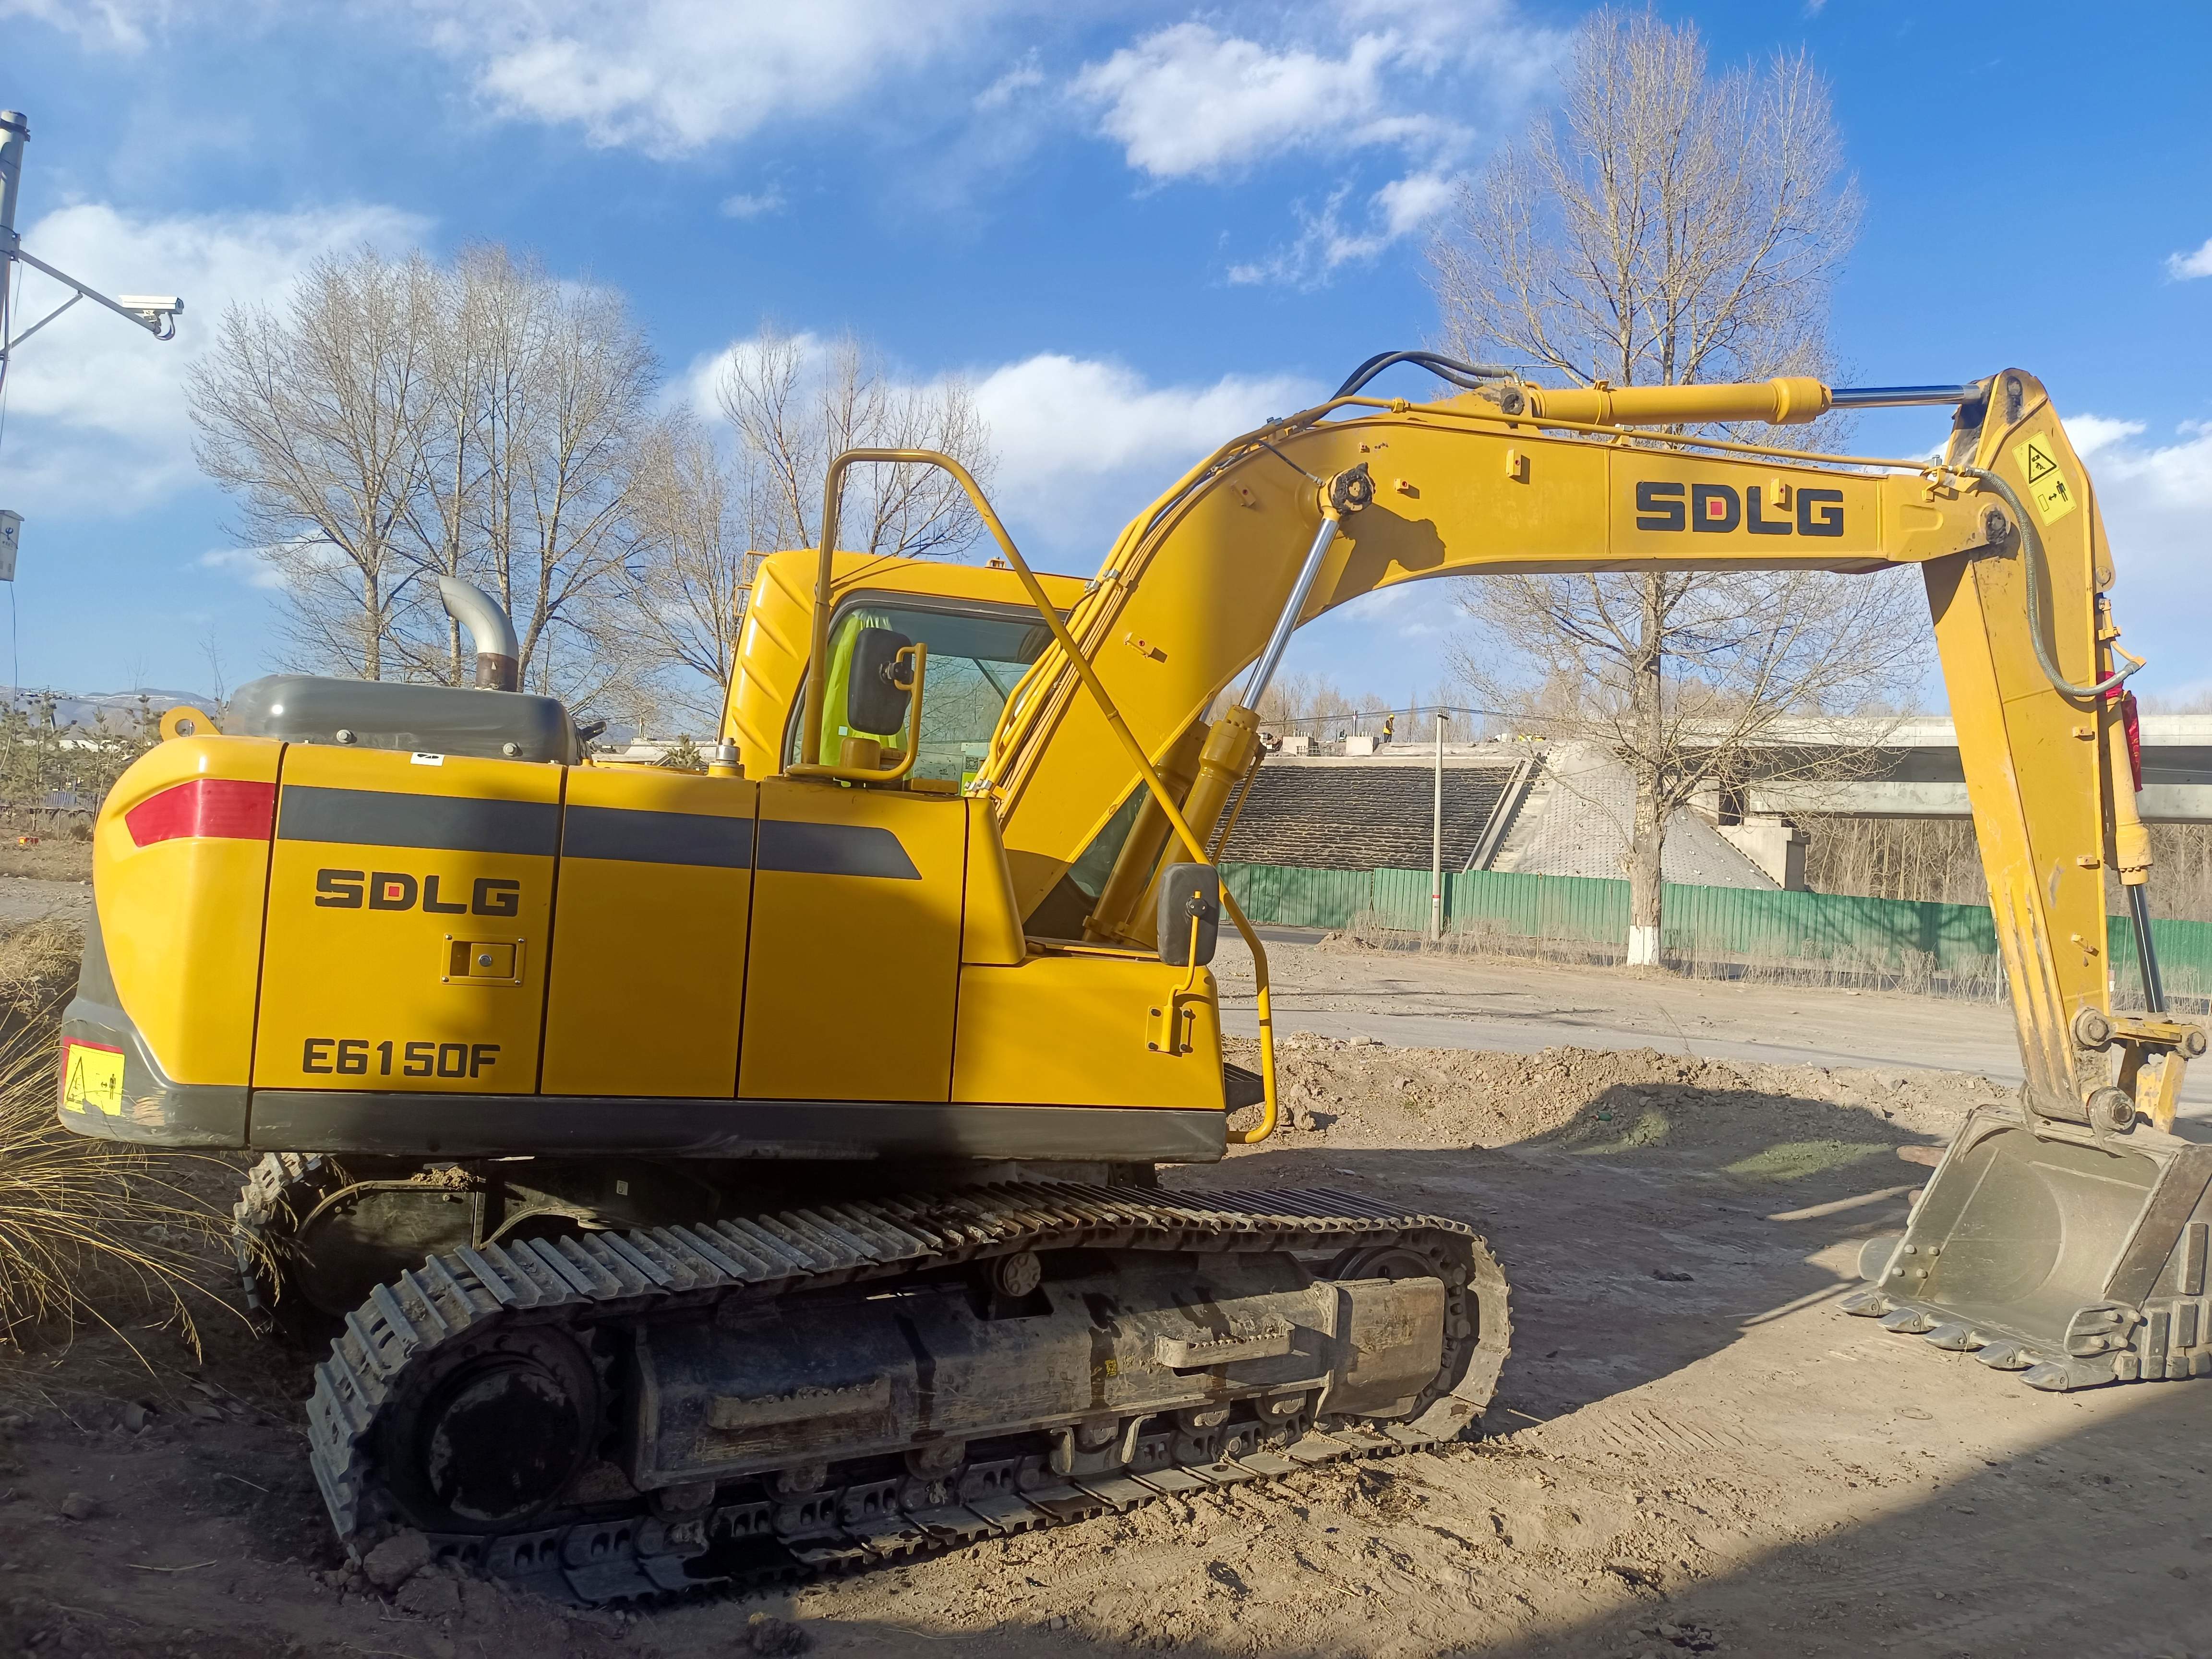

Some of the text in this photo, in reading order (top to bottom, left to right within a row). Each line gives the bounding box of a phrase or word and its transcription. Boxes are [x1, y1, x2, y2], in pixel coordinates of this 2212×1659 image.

[1636, 481, 1844, 537] SDLG
[314, 868, 520, 917] SDLG
[302, 1038, 501, 1079] E6150F
